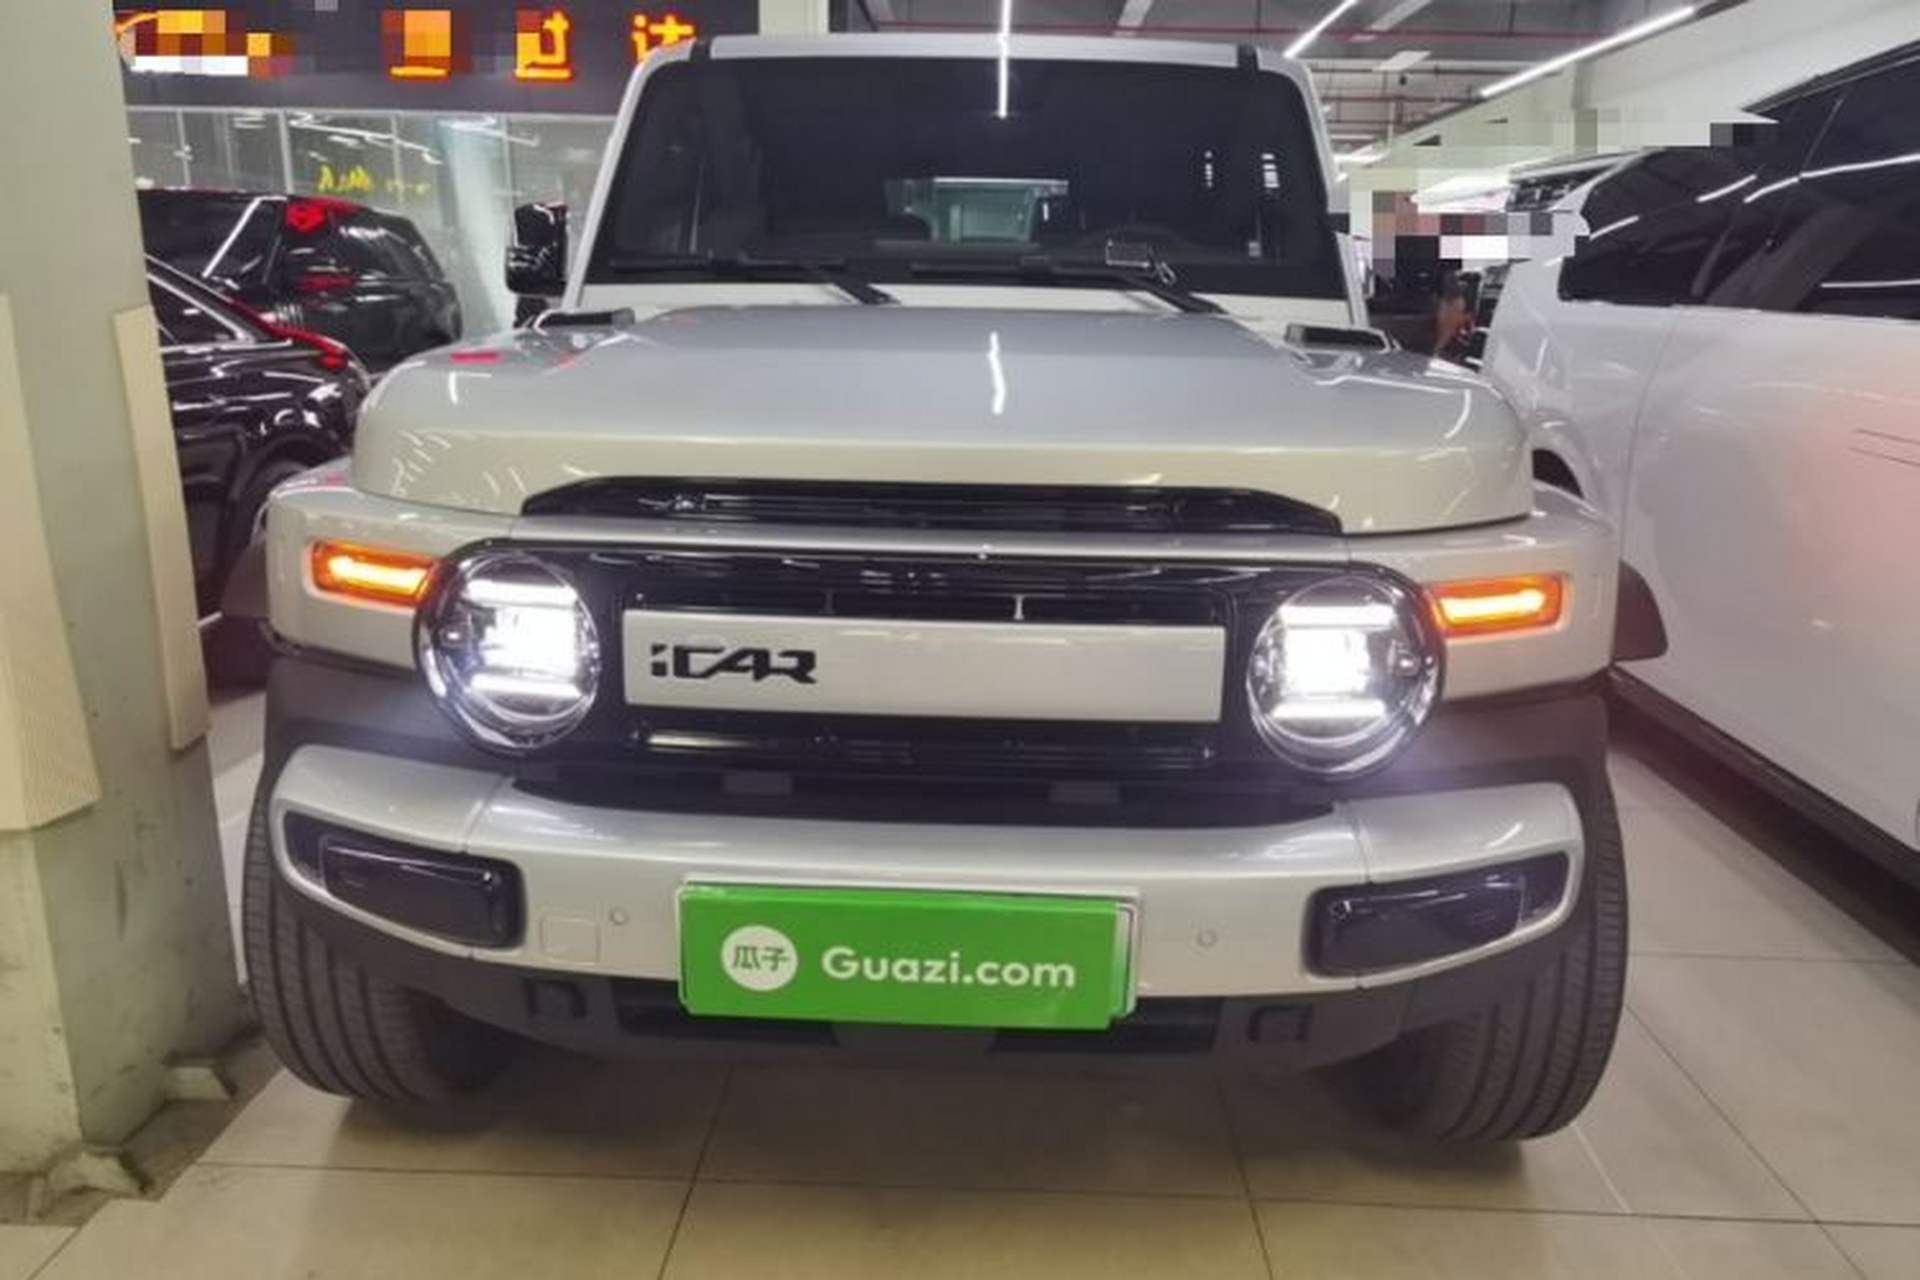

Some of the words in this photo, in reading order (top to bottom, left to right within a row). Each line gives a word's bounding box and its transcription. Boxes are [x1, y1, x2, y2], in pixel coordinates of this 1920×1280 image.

[651, 643, 817, 684] iCAR
[732, 945, 791, 972] 瓜子
[821, 945, 1075, 988] Guazi.com
